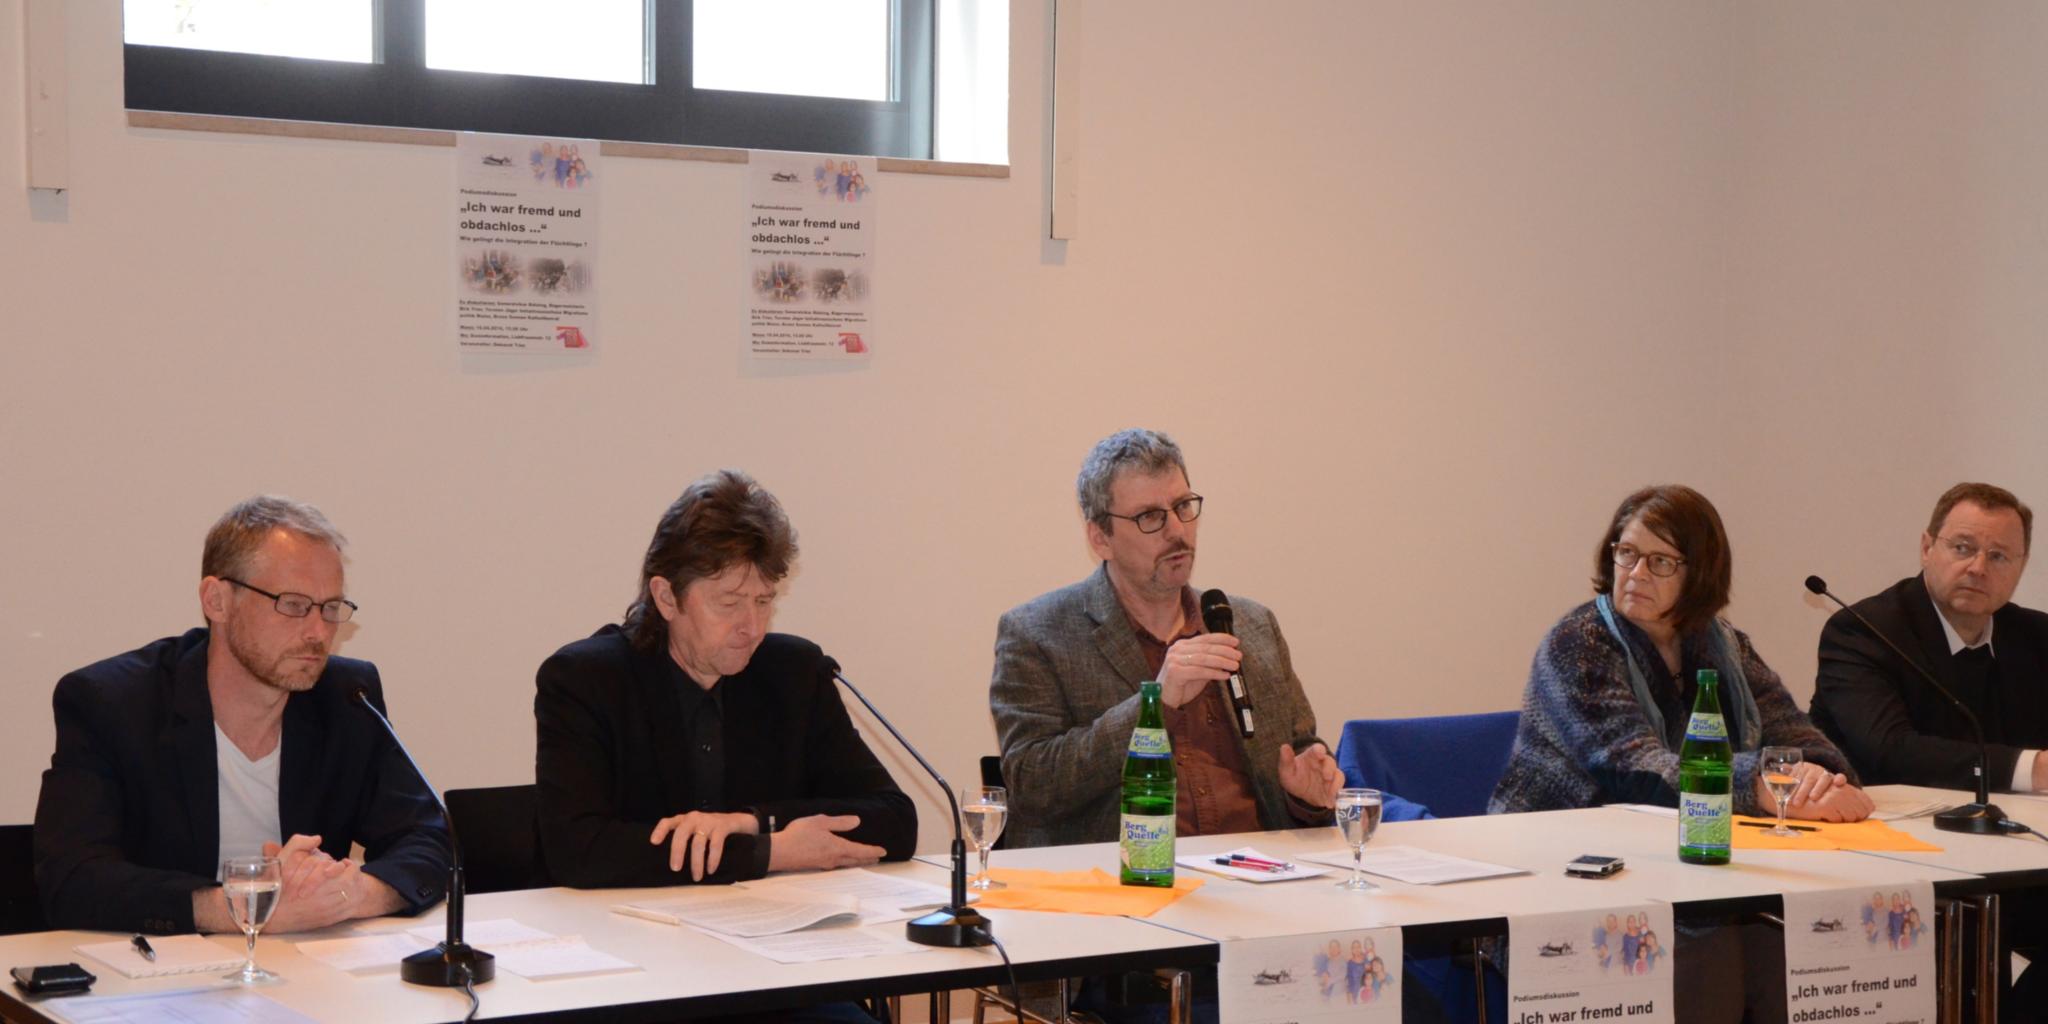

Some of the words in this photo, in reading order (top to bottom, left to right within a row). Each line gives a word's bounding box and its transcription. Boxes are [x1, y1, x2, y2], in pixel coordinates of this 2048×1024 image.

[460, 202, 486, 214] „Ich
[491, 204, 514, 214] war
[518, 204, 554, 216] fremd
[558, 208, 581, 218] und
[460, 220, 526, 232] obdachlos
[752, 216, 776, 228] „Ich
[779, 219, 800, 228] war
[804, 218, 836, 229] fremd
[840, 221, 860, 230] und
[752, 233, 810, 244] obdachlos
[1685, 800, 1708, 810] Berg
[1688, 806, 1720, 818] Quelle
[1125, 821, 1148, 833] Berg
[1127, 830, 1160, 840] Quelle
[1791, 965, 1850, 976] Podiumsdiskussion
[1792, 985, 1818, 1001] „Ich
[1823, 984, 1848, 995] war
[1852, 977, 1889, 993] fremd
[1894, 974, 1917, 988] und
[1514, 990, 1580, 1002] Podiumsdiskussion
[1549, 1010, 1576, 1022] war
[1581, 1004, 1622, 1018] fremd
[1628, 1001, 1653, 1015] und
[1793, 1004, 1860, 1023] obdachlos
